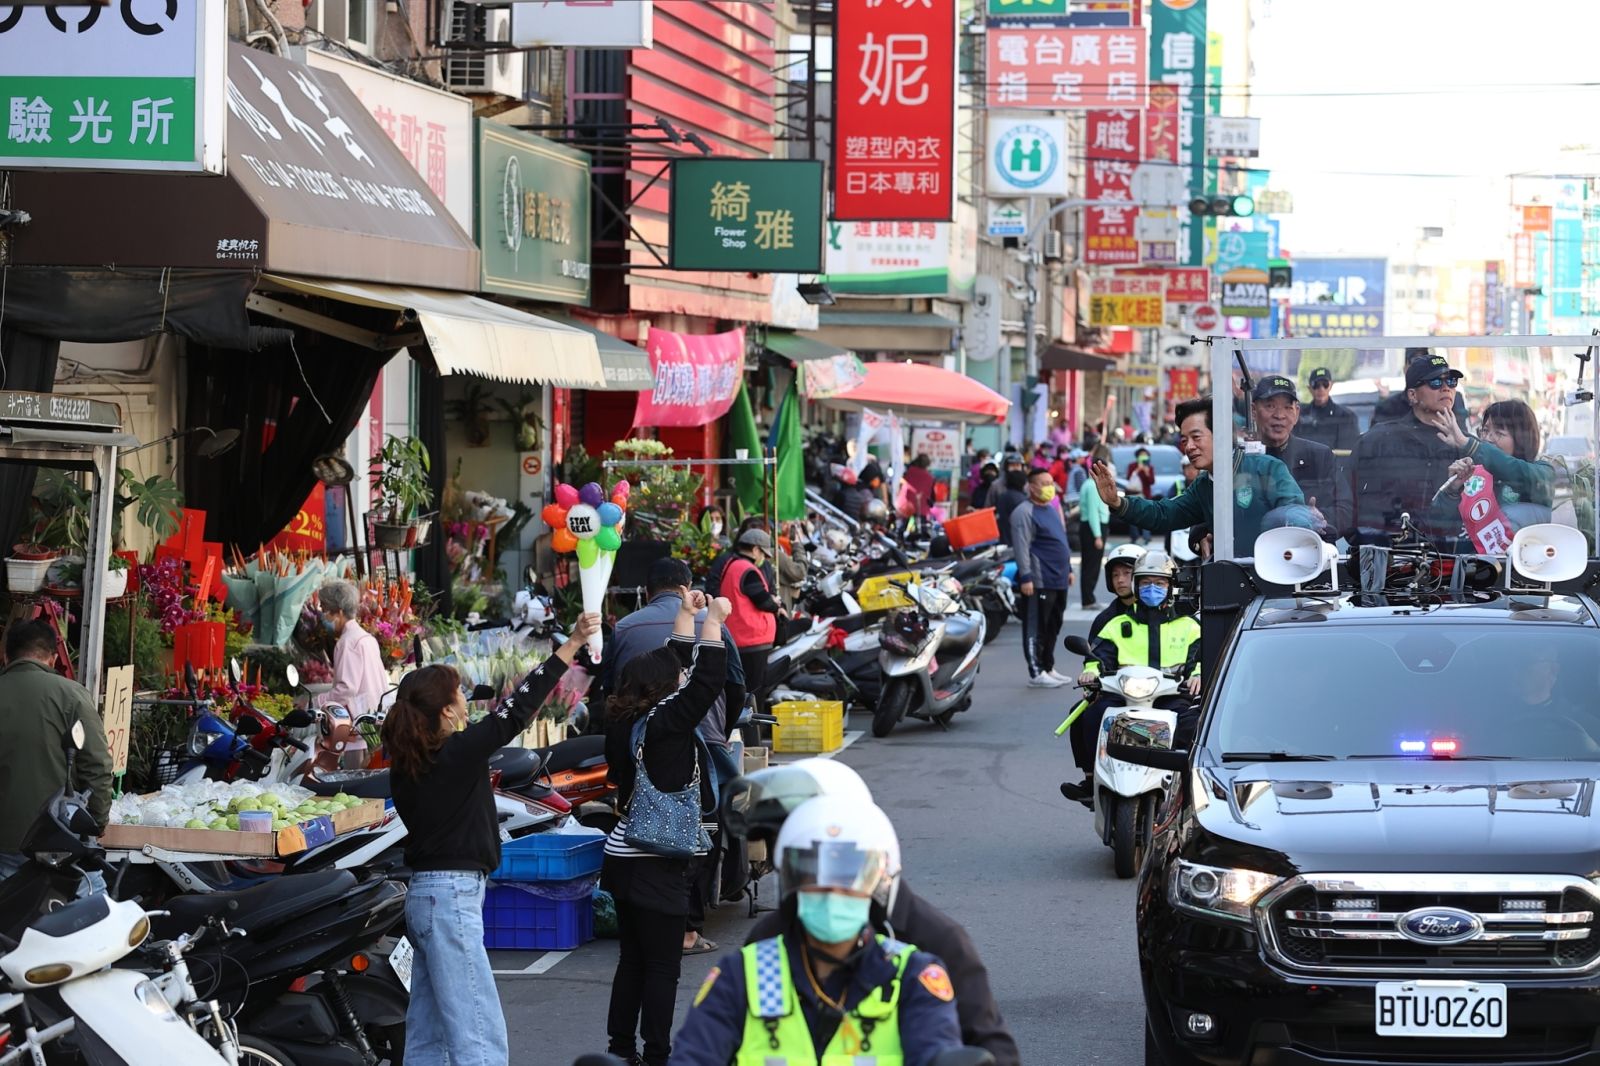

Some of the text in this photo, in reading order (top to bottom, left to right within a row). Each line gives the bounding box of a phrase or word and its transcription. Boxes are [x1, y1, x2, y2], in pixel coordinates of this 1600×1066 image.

[997, 35, 1137, 66] 電台廣告
[997, 71, 1137, 102] 指定店
[8, 95, 175, 145] 驗光所
[845, 136, 940, 159] 塑型內衣
[846, 172, 939, 194] 日本專利
[710, 181, 794, 250] 綺雅
[714, 227, 746, 237] Flower
[722, 238, 746, 249] Shop
[216, 252, 259, 260] 04-7111711
[1224, 283, 1267, 298] LAYA
[569, 516, 591, 525] STAY
[570, 525, 593, 533] REAL
[1418, 916, 1460, 933] Ford
